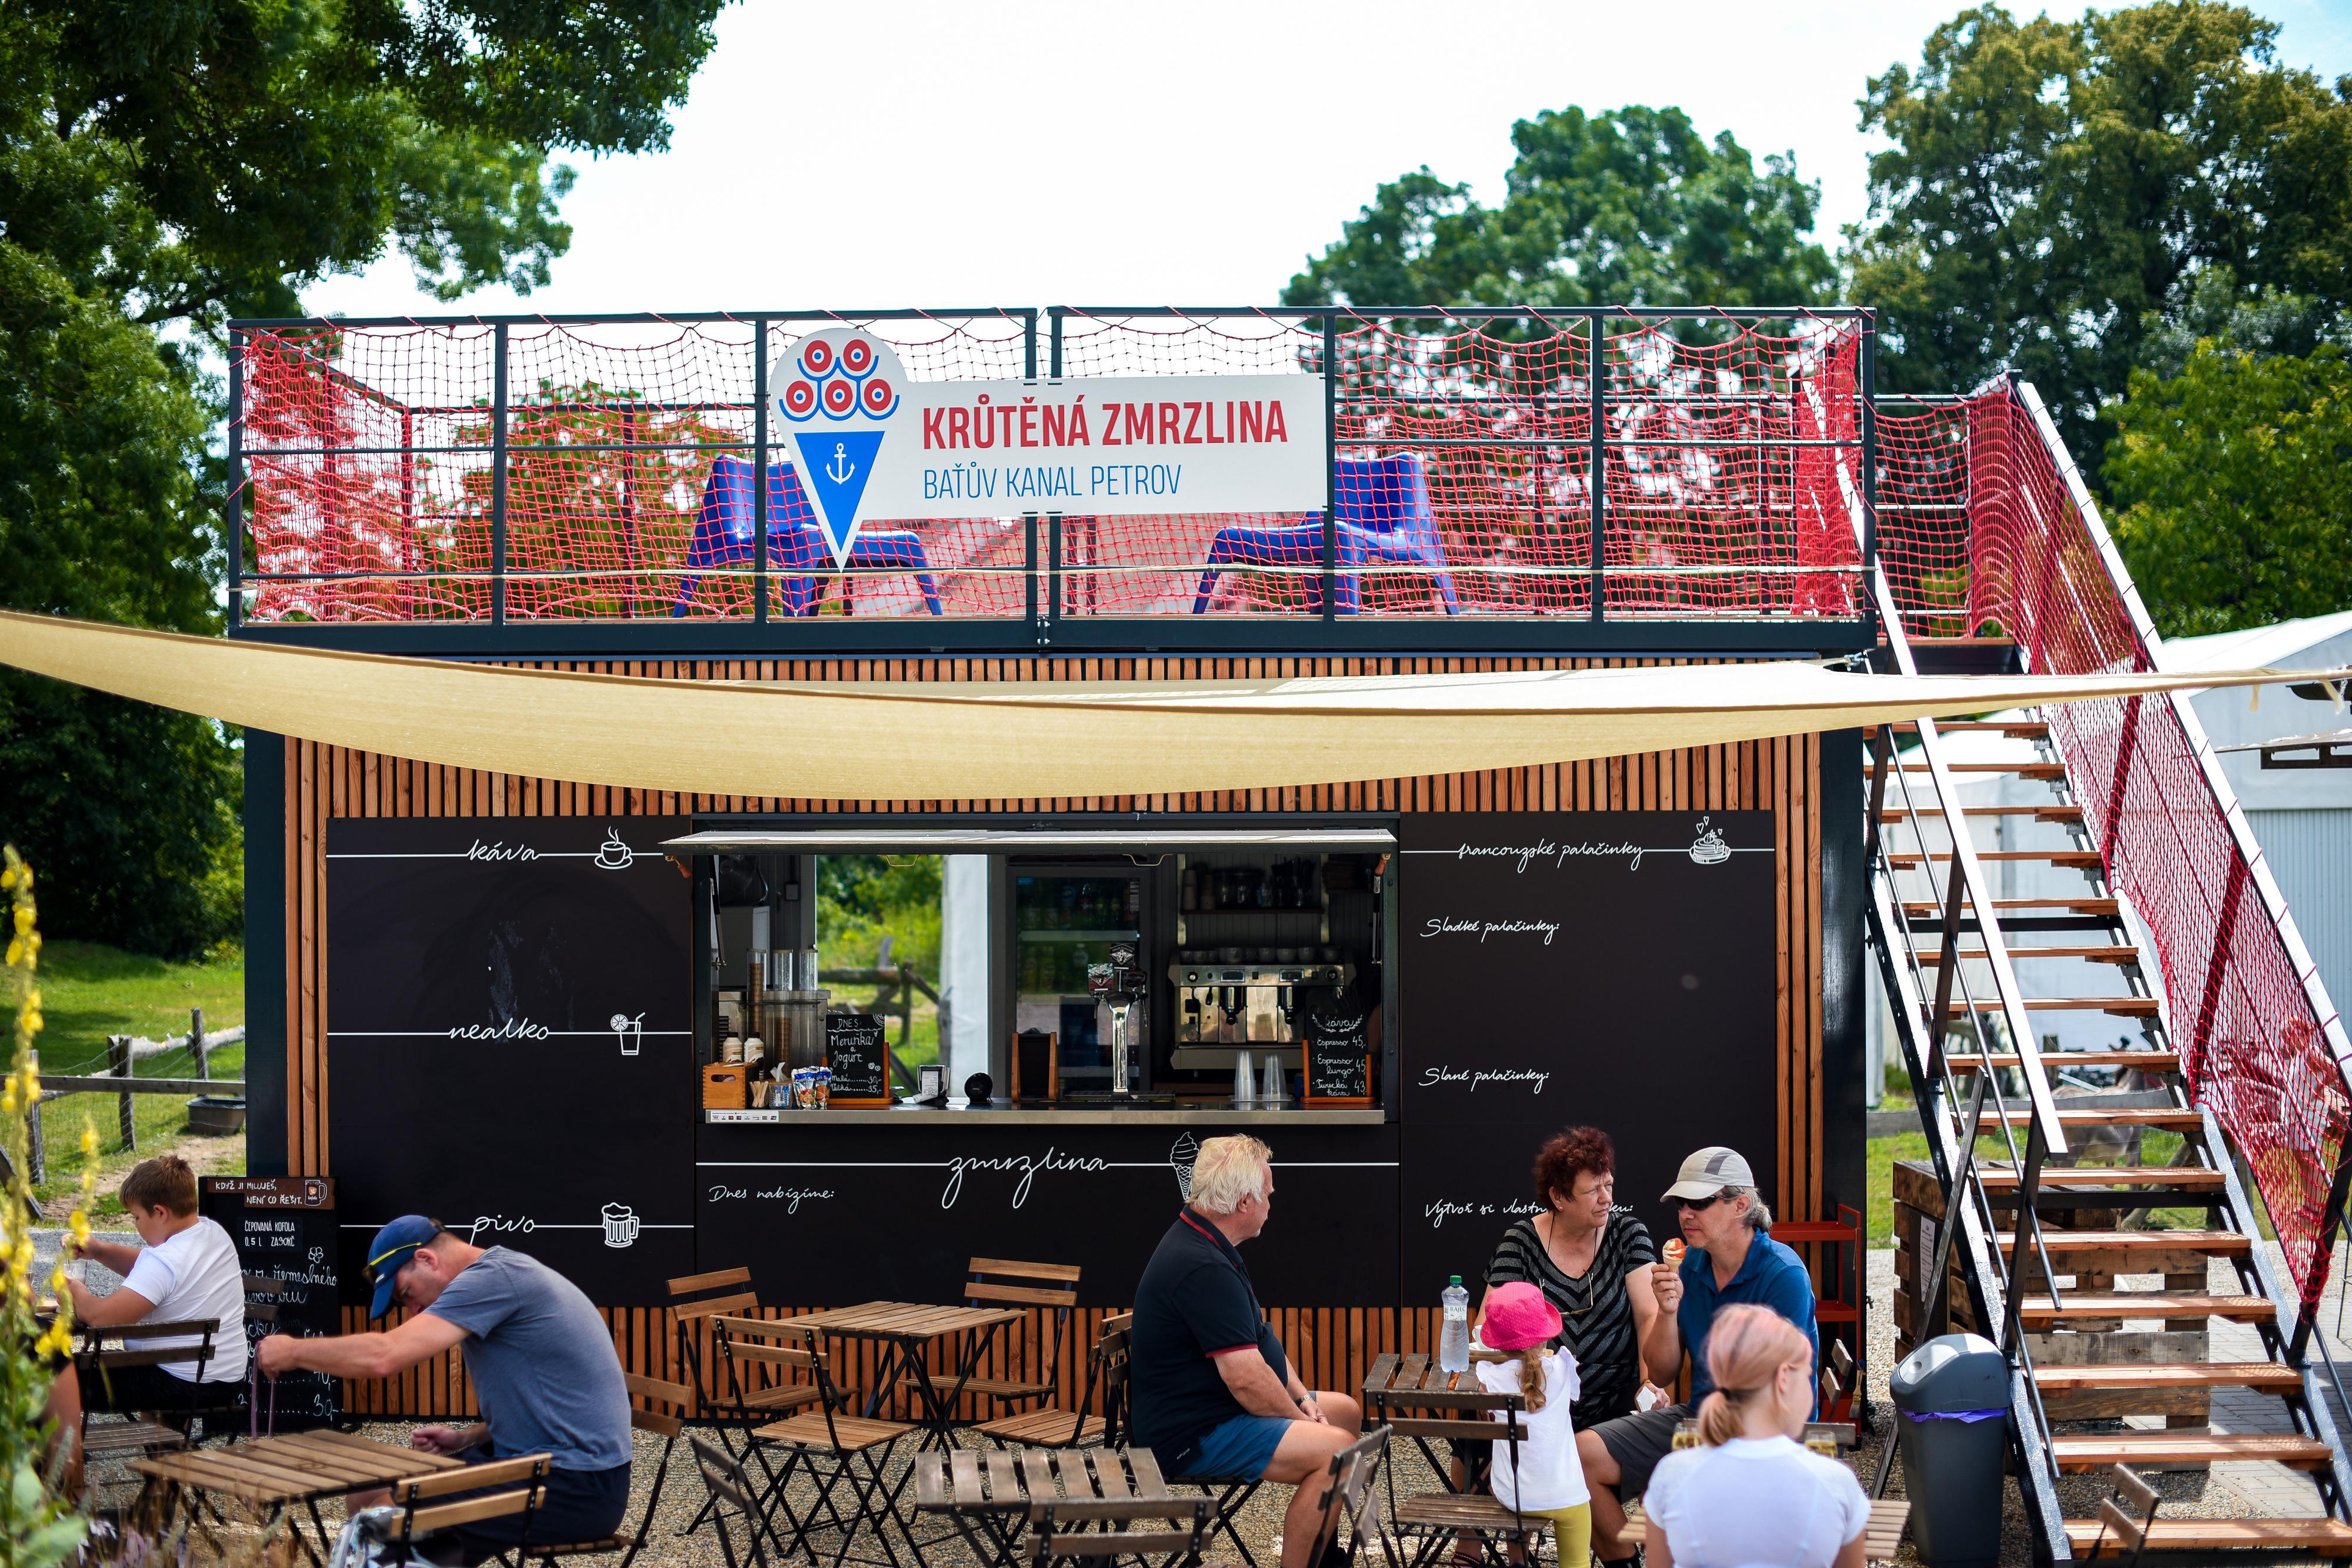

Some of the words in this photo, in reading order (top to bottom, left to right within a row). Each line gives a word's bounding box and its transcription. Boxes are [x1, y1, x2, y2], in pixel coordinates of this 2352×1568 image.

[924, 394, 1090, 450] KRŮTĚNÁ
[1102, 400, 1288, 446] ZMRZLINA
[924, 462, 998, 499] BAŤŮV
[1006, 466, 1083, 497] KANAL
[1091, 464, 1181, 496] PETROV
[467, 838, 541, 861] káva
[1458, 838, 1555, 874] francouzské
[1557, 841, 1644, 871] palačinky
[1420, 917, 1479, 937] Sladké
[1481, 920, 1560, 945] palačinky:
[449, 1017, 549, 1040] nealko
[1317, 1037, 1348, 1049] Espresso
[833, 1050, 863, 1069] Jogurt
[1318, 1054, 1353, 1066] Espresso
[1317, 1079, 1348, 1088] Turecká
[1327, 1066, 1354, 1078] lungo
[1418, 1065, 1469, 1086] Slané
[1471, 1069, 1550, 1094] palačinky:
[215, 1180, 235, 1190] KDYŽ
[246, 1179, 277, 1191] MILUJEŠ,
[941, 1146, 1110, 1209] zmrzlina
[246, 1195, 266, 1205] NENÍ
[268, 1196, 277, 1204] CO
[709, 1185, 747, 1202] Dnes
[756, 1186, 835, 1214] nabízíme:
[1425, 1199, 1474, 1228] Vytvoř
[1479, 1204, 1495, 1215] si
[245, 1220, 272, 1232] ČEPOVANÁ
[275, 1222, 295, 1232] KOFOLA
[469, 1214, 534, 1247] pivo
